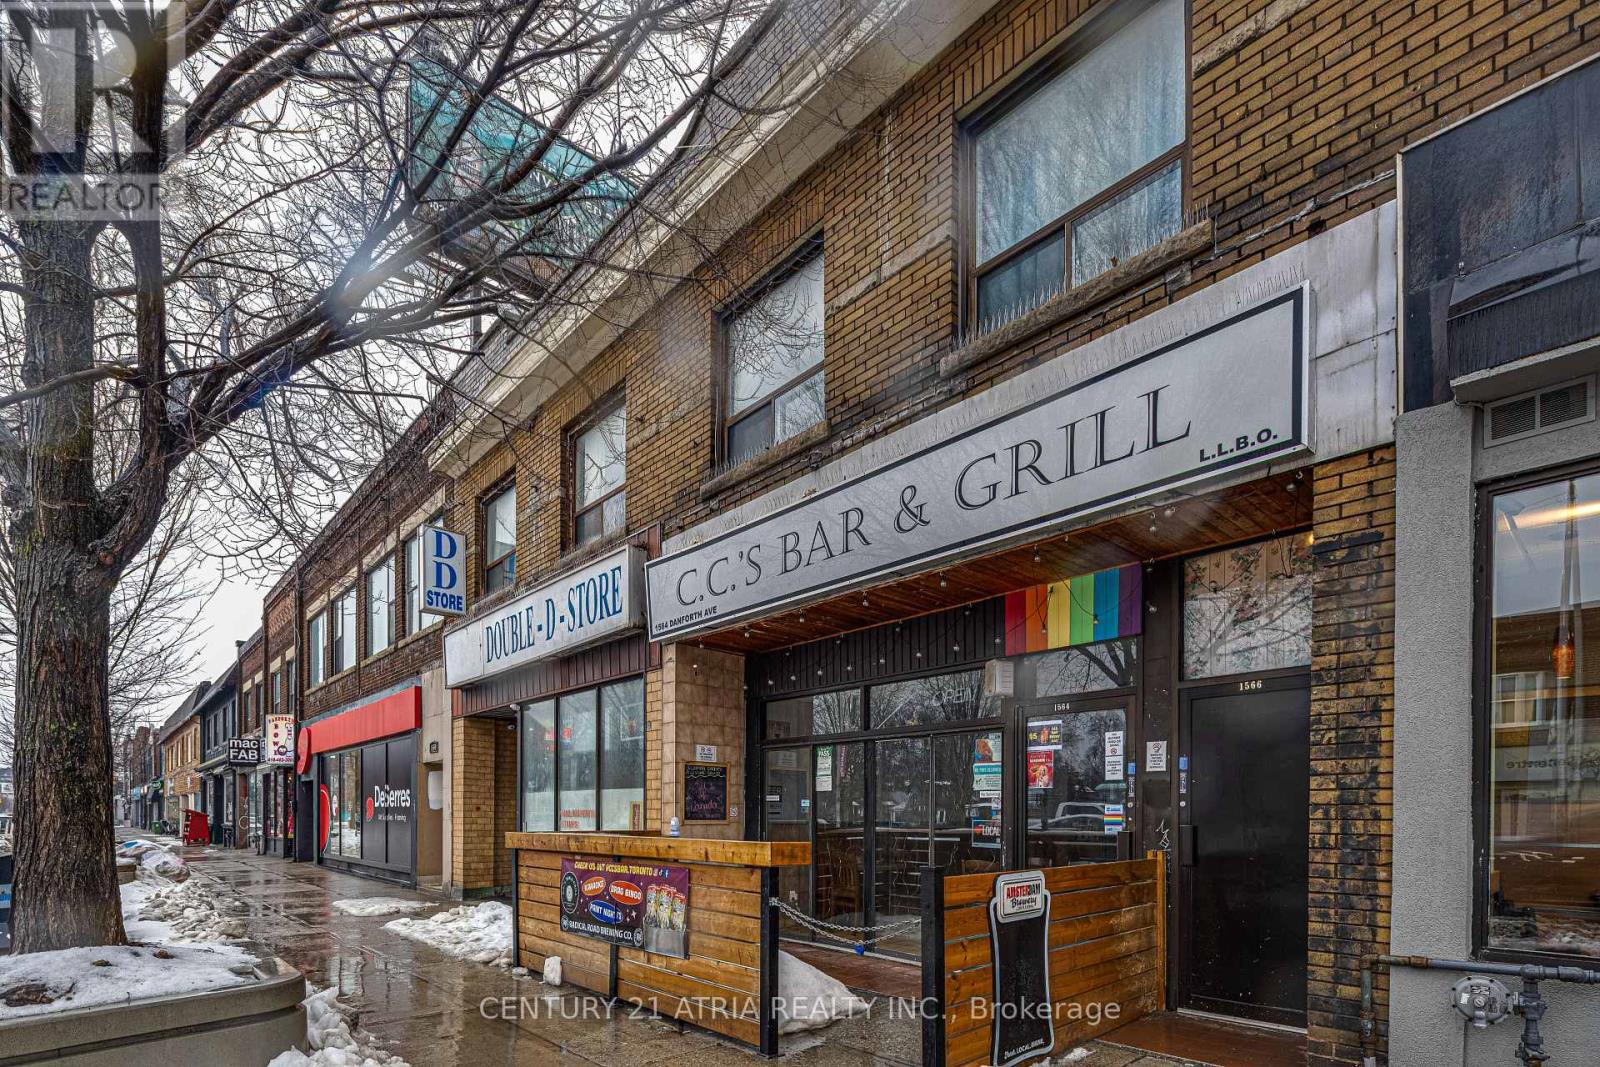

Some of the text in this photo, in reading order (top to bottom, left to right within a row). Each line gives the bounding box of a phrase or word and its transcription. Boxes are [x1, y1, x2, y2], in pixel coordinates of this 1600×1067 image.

[1199, 428, 1278, 463] L.L.B.O.
[676, 384, 1191, 606] C.C.'S BAR & GRILL
[426, 590, 463, 612] STORE
[669, 609, 703, 628] DANFORTH
[704, 605, 718, 618] AVE
[1240, 679, 1262, 691] 1566
[1053, 702, 1070, 712] 1564
[229, 739, 258, 749] mac
[229, 749, 258, 760] FAB
[374, 784, 411, 808] DeSerres
[610, 885, 642, 900] DRAG BINGO
[1006, 882, 1041, 900] AMSTERDAM
[587, 923, 600, 935] ROAD
